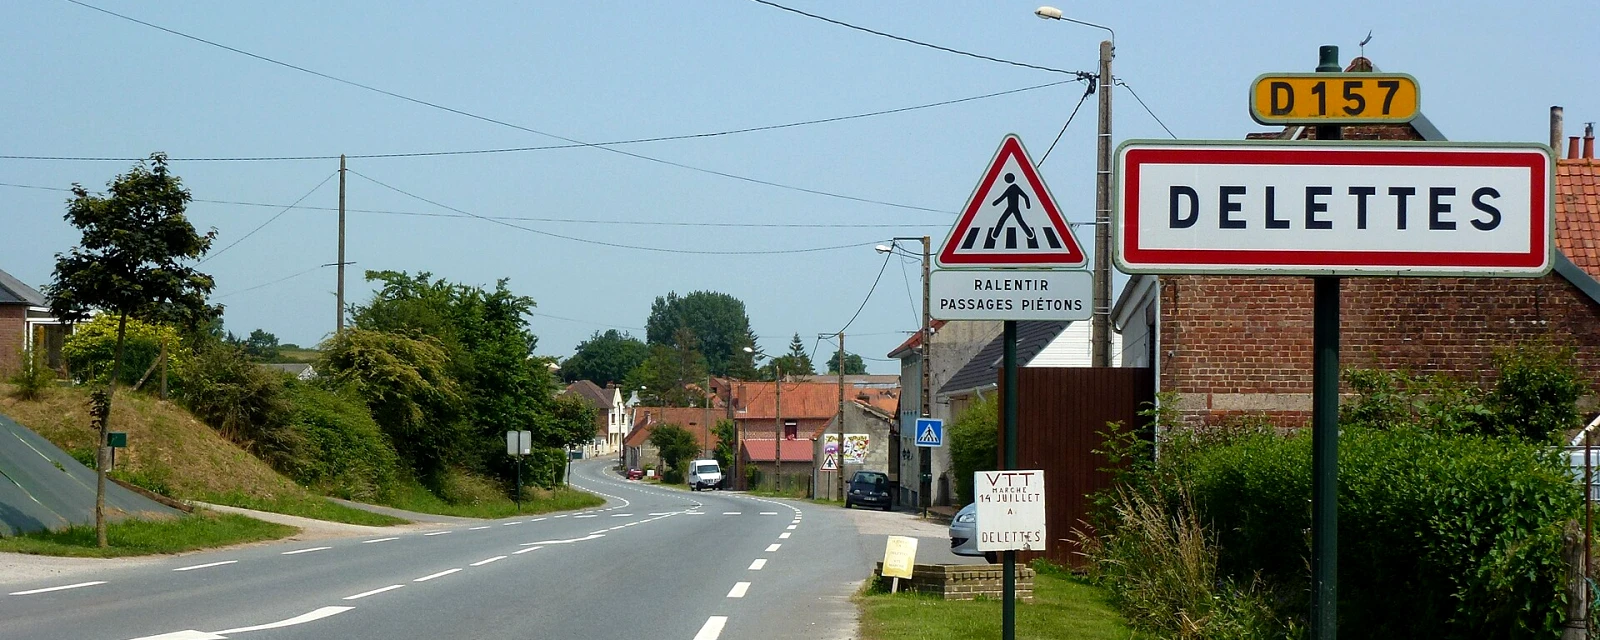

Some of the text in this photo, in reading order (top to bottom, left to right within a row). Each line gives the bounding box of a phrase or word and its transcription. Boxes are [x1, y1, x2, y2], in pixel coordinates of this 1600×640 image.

[1169, 185, 1502, 232] DELETTES
[974, 279, 1048, 290] RALENTIR
[940, 297, 1082, 310] PASSAGES PIÉTONS
[986, 473, 1034, 486] VTT
[979, 494, 1040, 502] 14 JUILLET
[982, 531, 1041, 542] DELETTES
